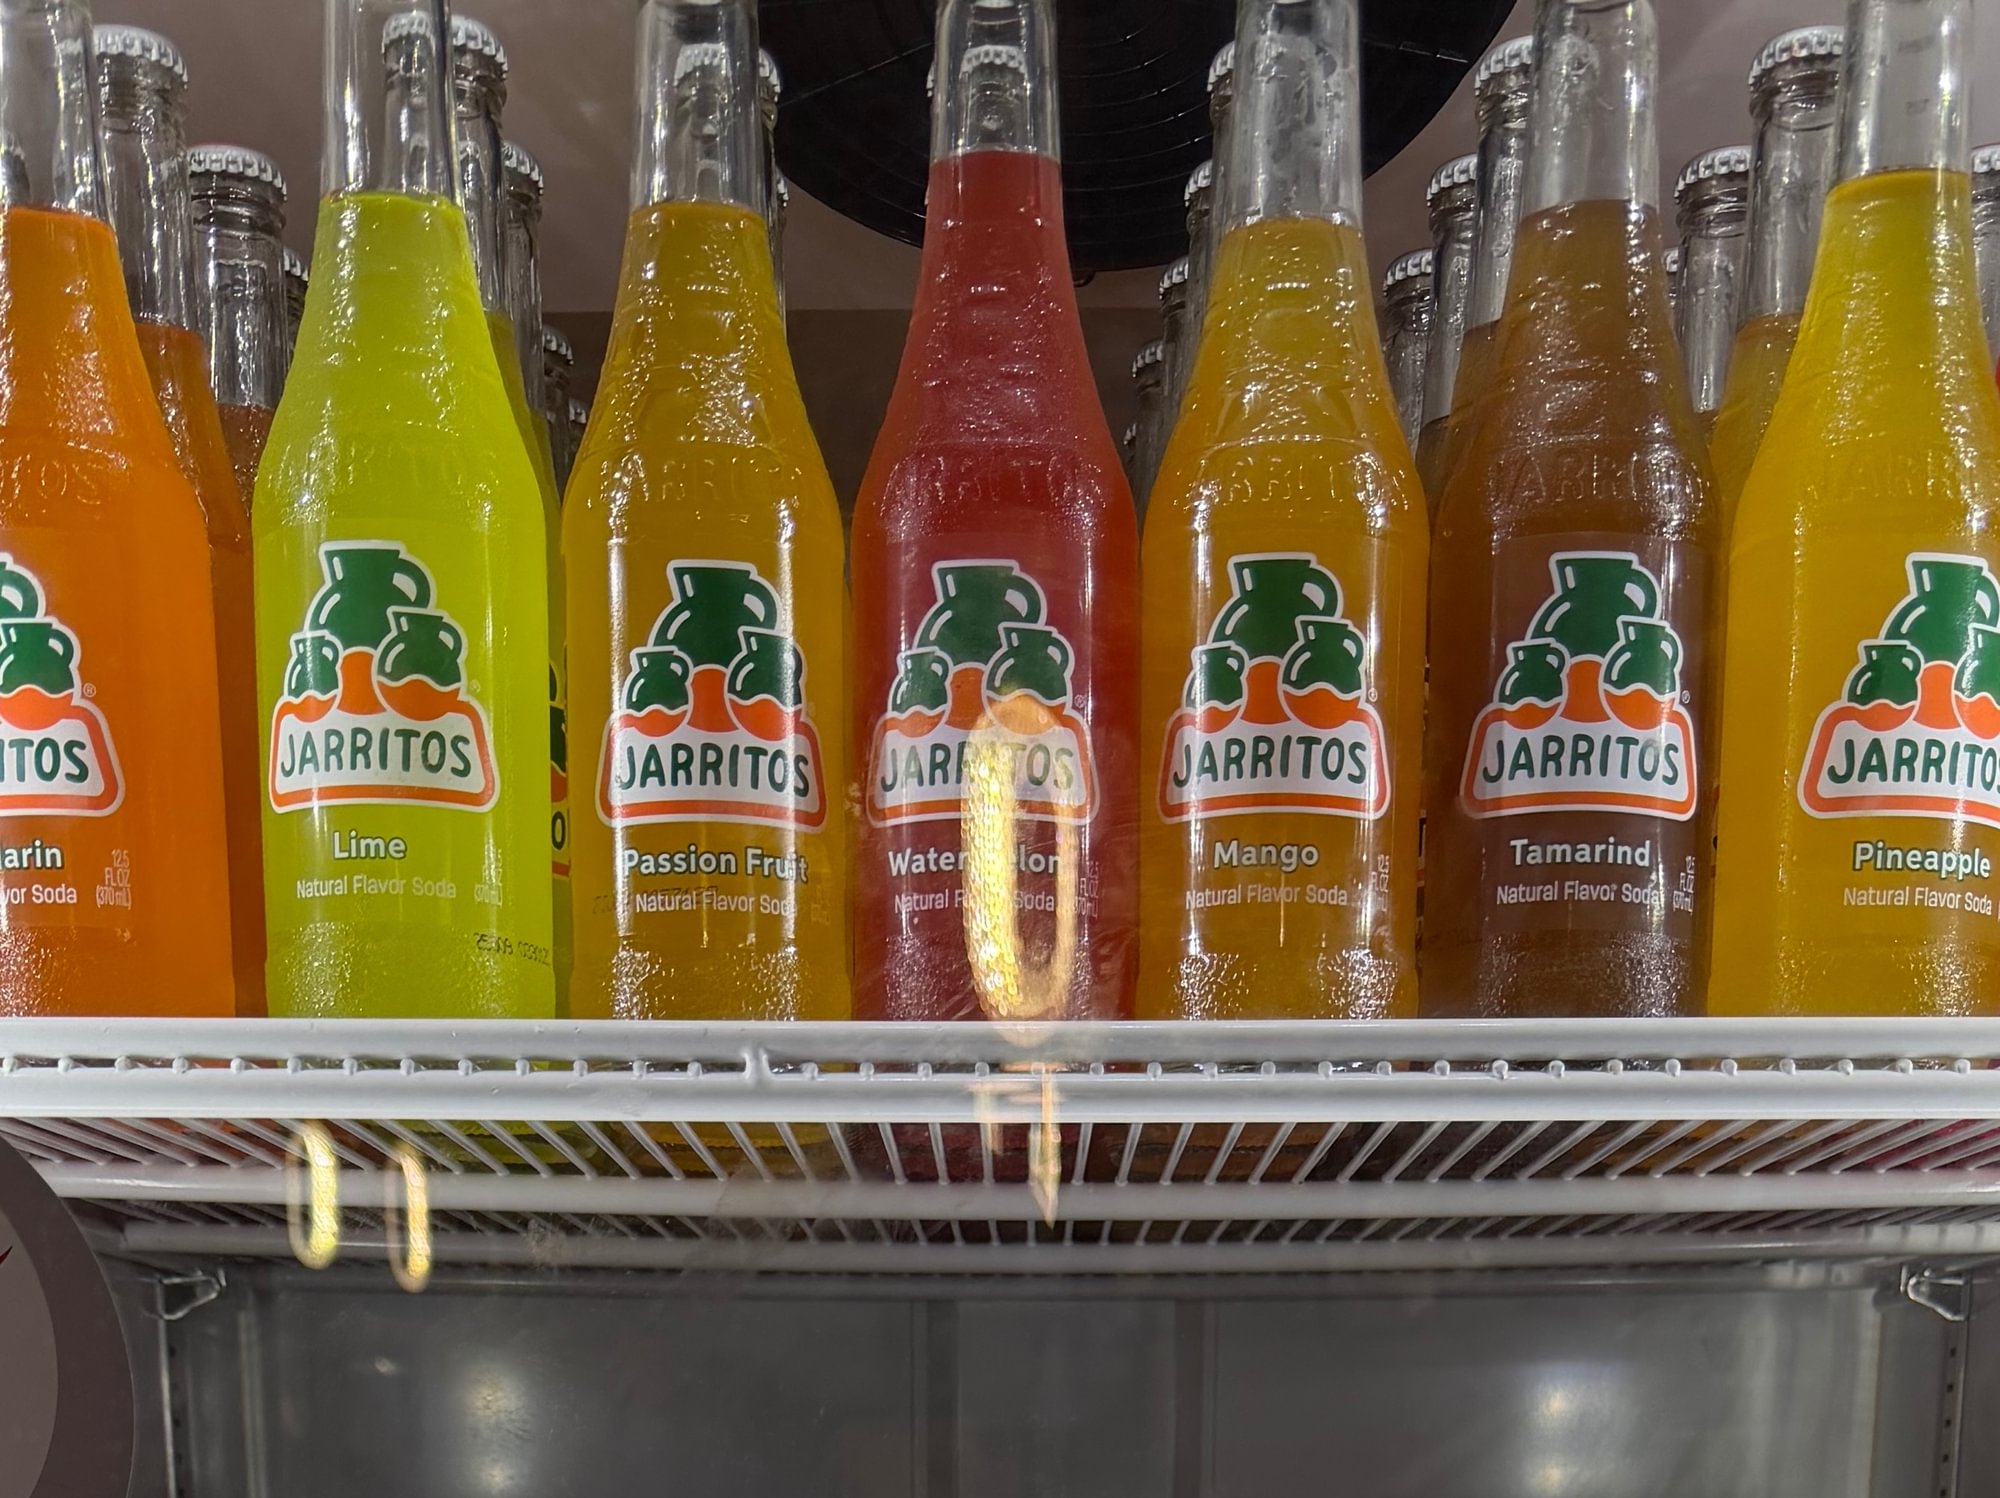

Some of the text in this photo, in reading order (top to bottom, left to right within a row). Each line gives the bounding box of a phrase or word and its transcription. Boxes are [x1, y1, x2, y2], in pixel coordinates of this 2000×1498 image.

[281, 727, 472, 778] JARRITOS
[1173, 735, 1366, 788] JARRITOS
[1482, 734, 1679, 786] JARRITOS
[1827, 738, 2000, 795] JARRITO
[616, 742, 809, 797] JARRITOS
[0, 838, 63, 869] arin
[332, 829, 407, 860] Lime
[1213, 840, 1319, 873] Mango
[1510, 837, 1650, 867] Tamarind
[623, 845, 809, 883] Passion Fruit
[1854, 840, 1992, 881] Pineapple
[31, 883, 77, 904] Soda
[296, 875, 456, 899] Natural Flavor Soda
[635, 892, 696, 913] Natural
[702, 891, 755, 913] Flavor
[894, 889, 948, 914] Natural
[1014, 891, 1055, 912] Soda
[1185, 885, 1241, 909] Natural
[1247, 884, 1300, 903] Flavor
[1306, 884, 1348, 906] Soda
[1497, 881, 1660, 906] Natural Flavor Soda
[1843, 886, 1992, 915] Natural Flavor Soda
